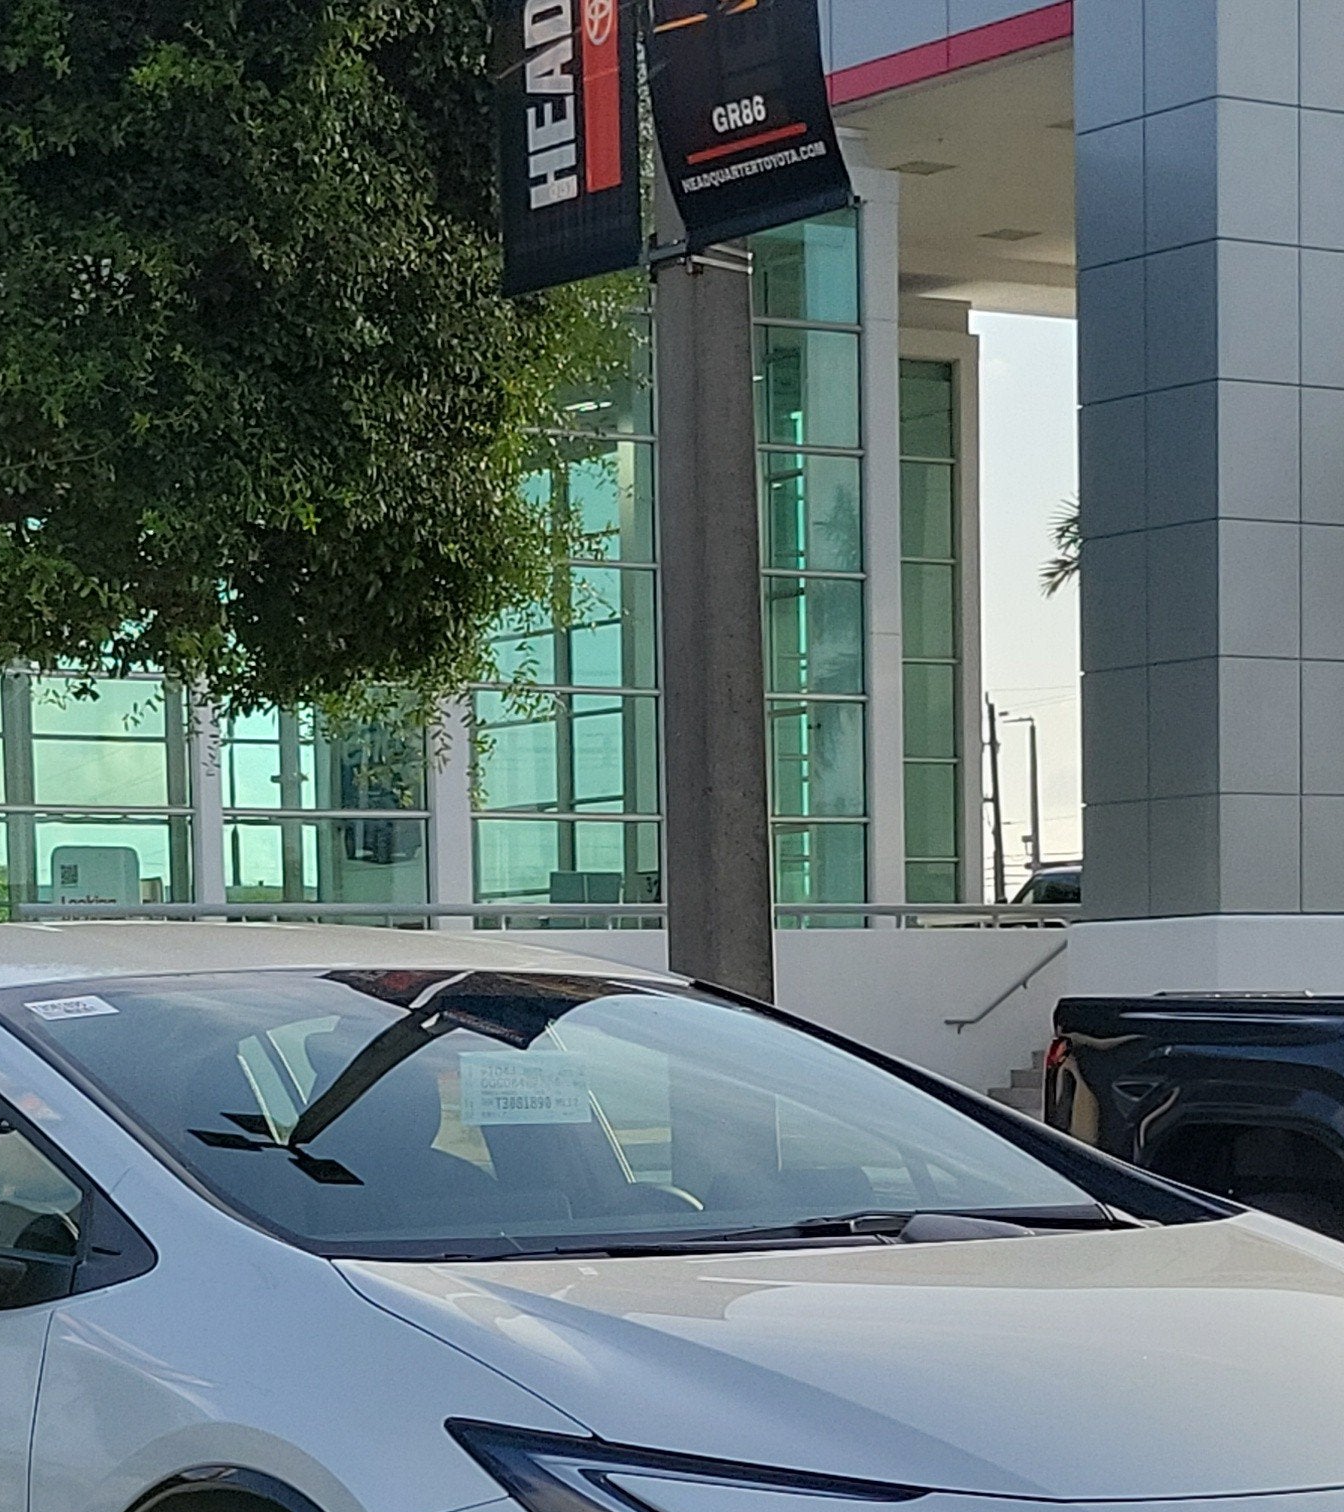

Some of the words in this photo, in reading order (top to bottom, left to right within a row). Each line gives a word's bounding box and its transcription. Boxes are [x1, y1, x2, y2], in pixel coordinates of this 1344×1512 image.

[523, 0, 578, 210] HEAD
[712, 95, 767, 133] GR86
[681, 140, 827, 194] HEADQUARTERTOYOTA.COM
